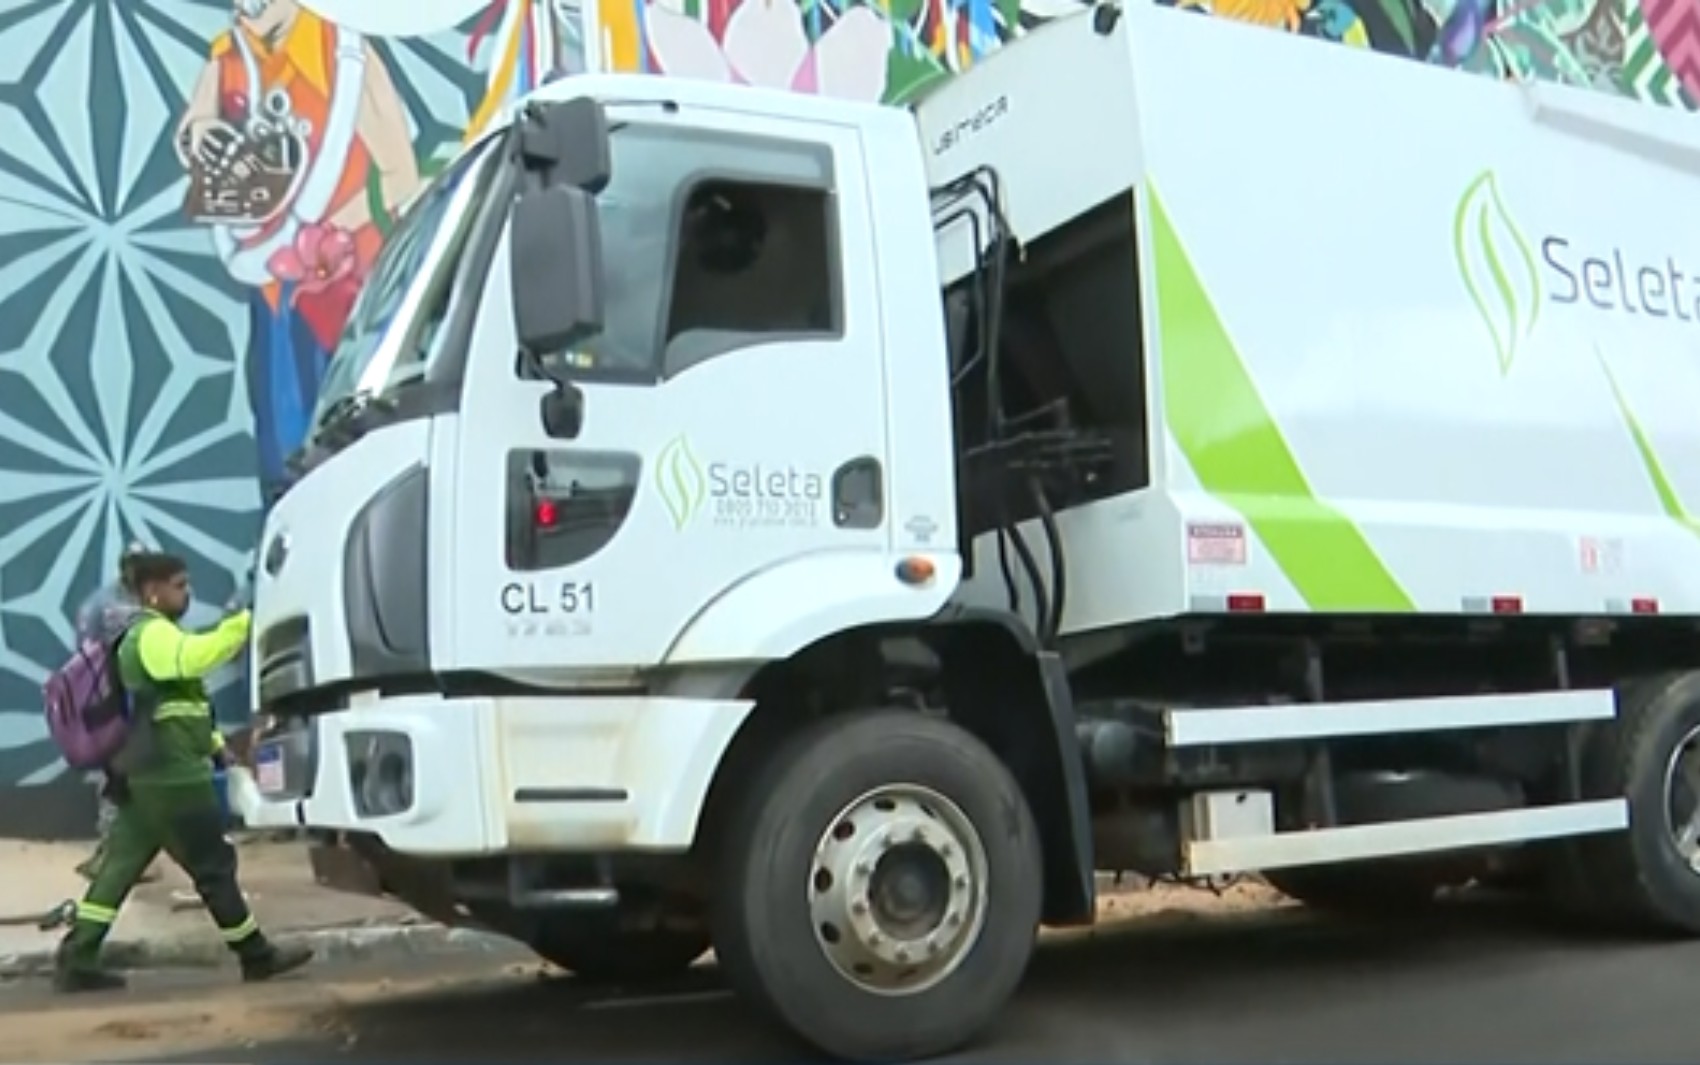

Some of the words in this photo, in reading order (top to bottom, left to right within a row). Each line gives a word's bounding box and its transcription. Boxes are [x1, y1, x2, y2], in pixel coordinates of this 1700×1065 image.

[708, 462, 821, 498] Seleta
[501, 582, 549, 614] CL
[560, 581, 593, 613] 51
